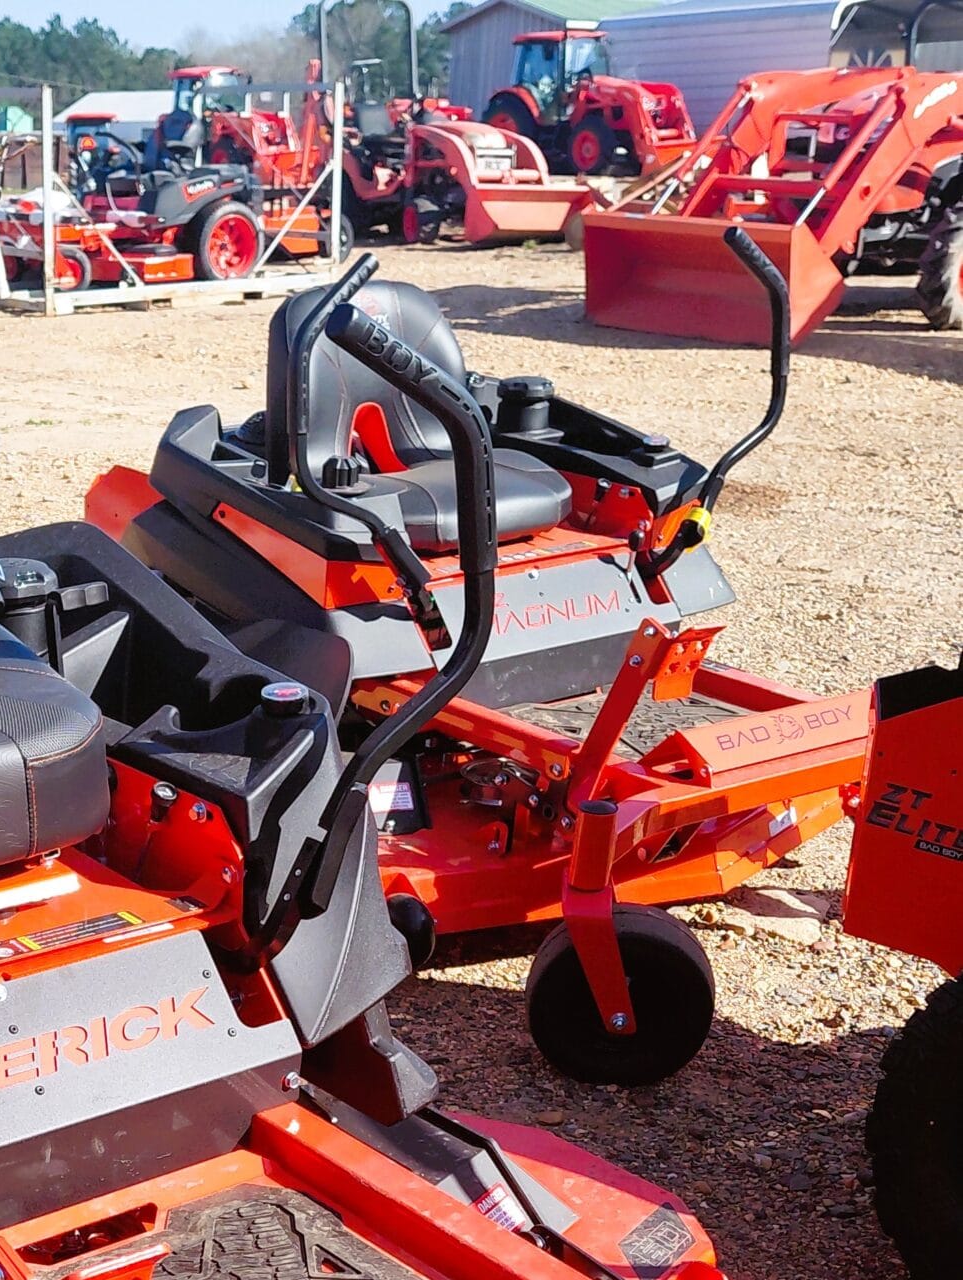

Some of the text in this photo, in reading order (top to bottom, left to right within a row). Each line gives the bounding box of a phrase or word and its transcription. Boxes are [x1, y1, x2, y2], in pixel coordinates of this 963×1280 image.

[358, 322, 438, 386] BOY
[716, 704, 852, 751] BAD BOY
[880, 782, 934, 810] ZT
[919, 841, 963, 860] BAD BOY
